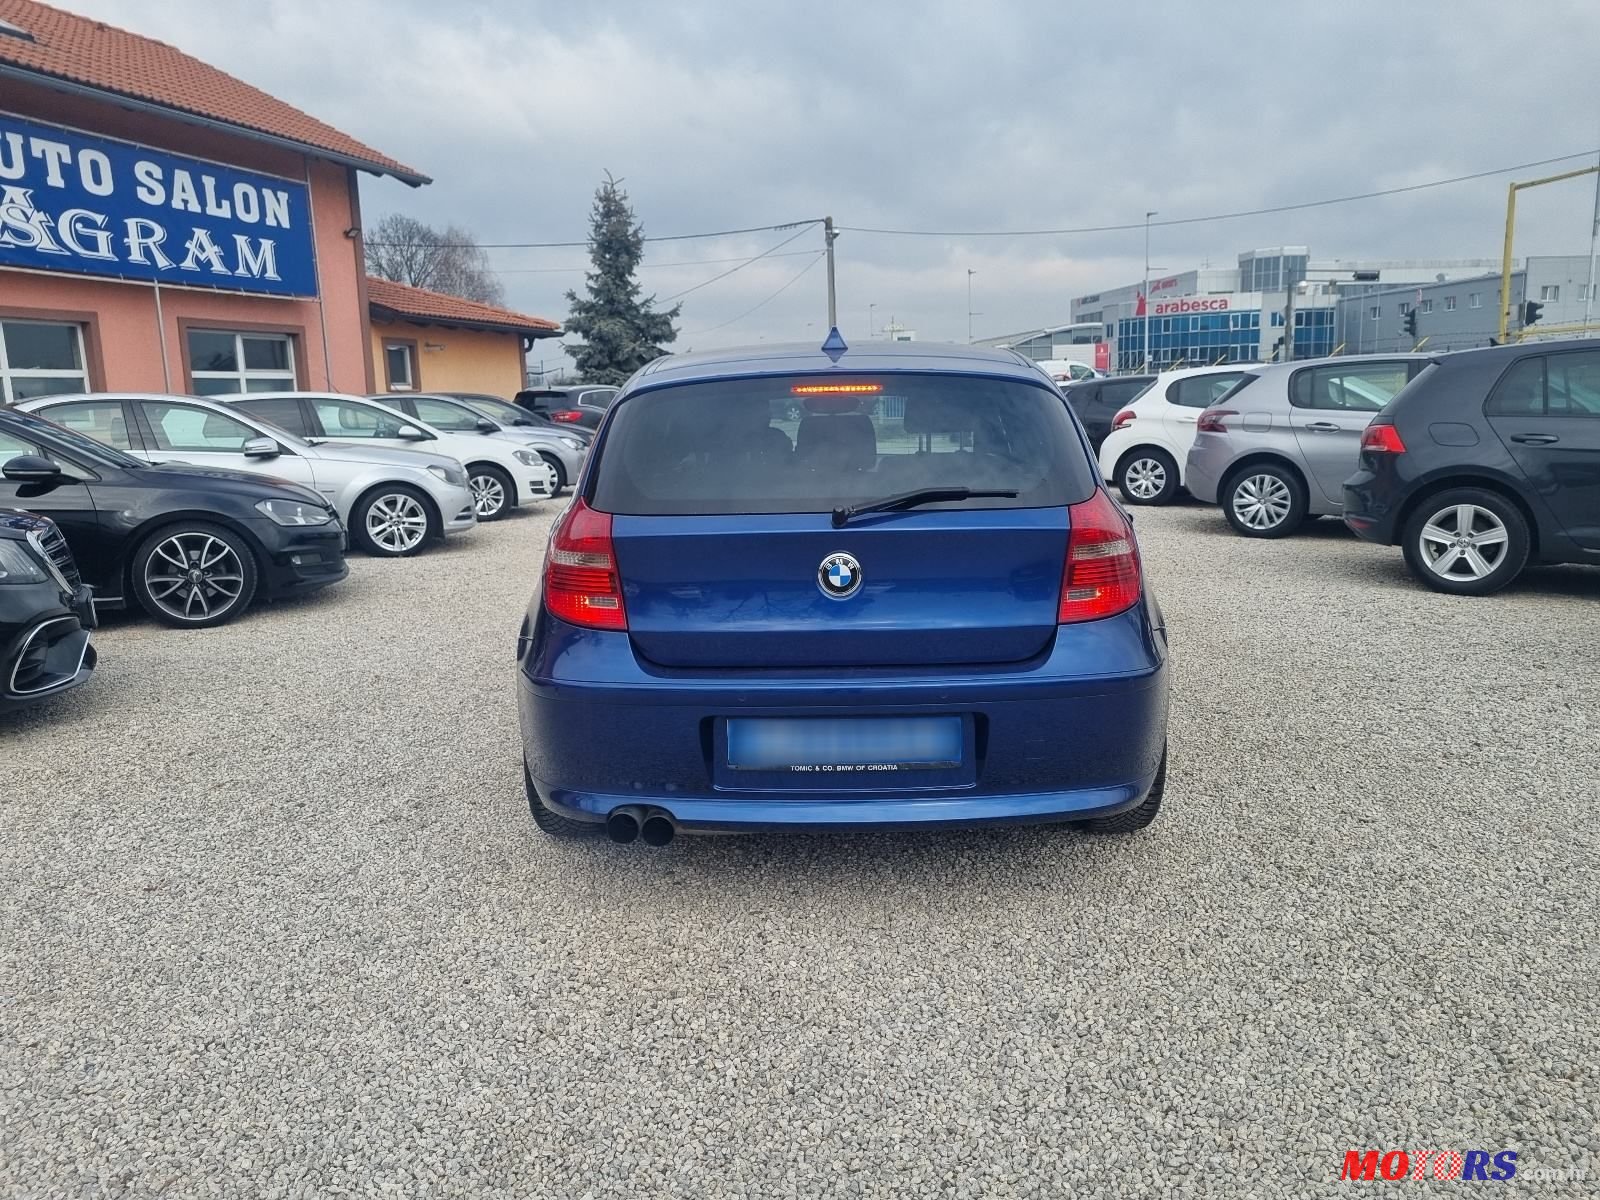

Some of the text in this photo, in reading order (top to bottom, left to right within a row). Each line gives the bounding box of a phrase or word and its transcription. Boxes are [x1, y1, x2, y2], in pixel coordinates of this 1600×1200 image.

[134, 161, 290, 229] SALON
[1155, 297, 1228, 314] arabesca
[825, 558, 855, 571] BMW
